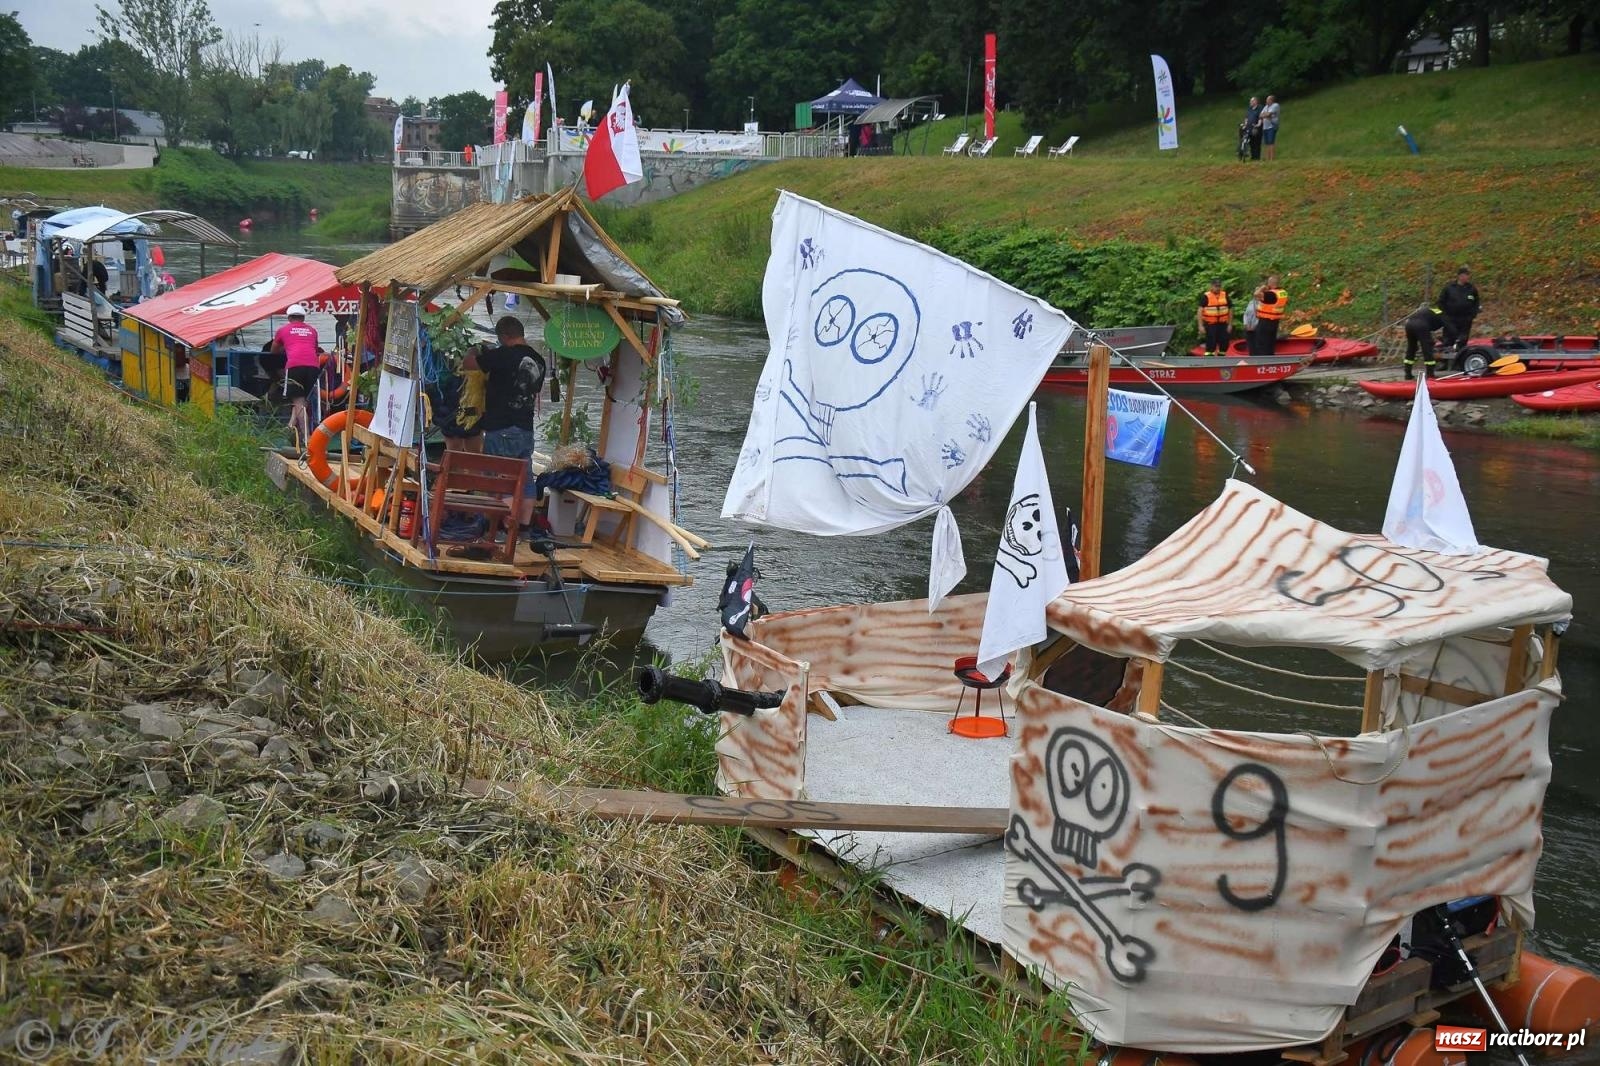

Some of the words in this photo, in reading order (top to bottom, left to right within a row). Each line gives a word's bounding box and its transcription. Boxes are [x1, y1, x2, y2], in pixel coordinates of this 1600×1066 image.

[298, 296, 360, 315] BŁAŻE
[685, 796, 841, 822] SOS
[1211, 763, 1289, 912] 9
